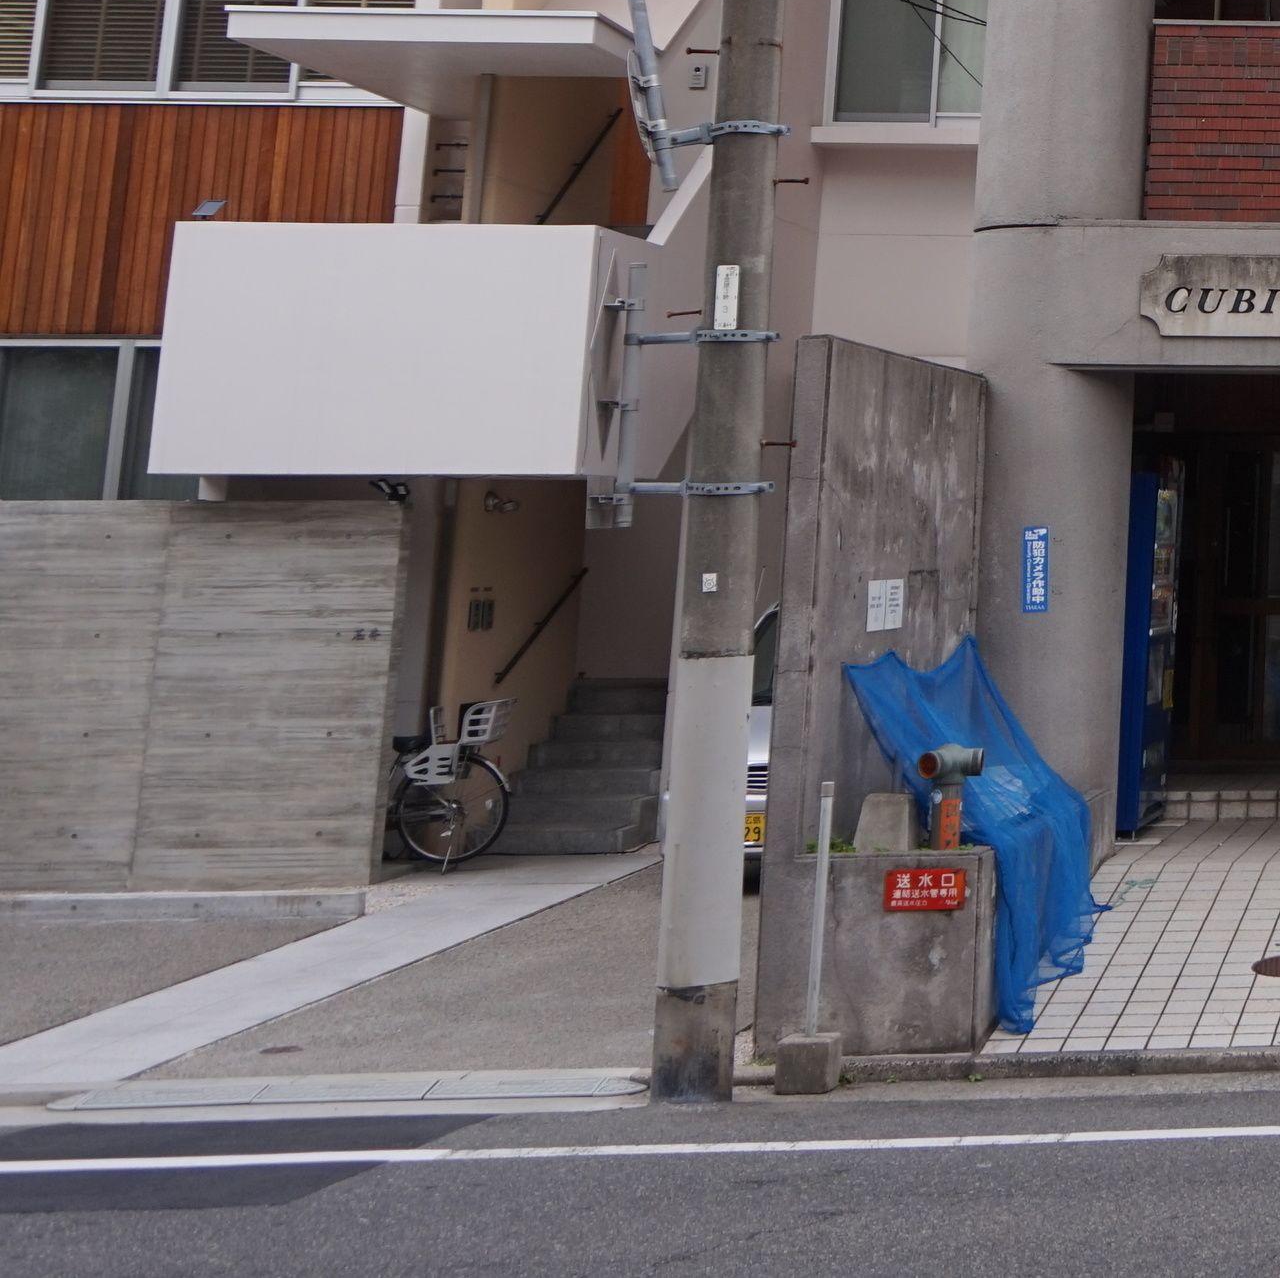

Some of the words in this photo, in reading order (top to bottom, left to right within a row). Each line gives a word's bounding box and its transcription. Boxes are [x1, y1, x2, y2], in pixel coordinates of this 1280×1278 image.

[1032, 540, 1045, 604] 防犯カメラ作動中
[896, 873, 955, 889] 送水口
